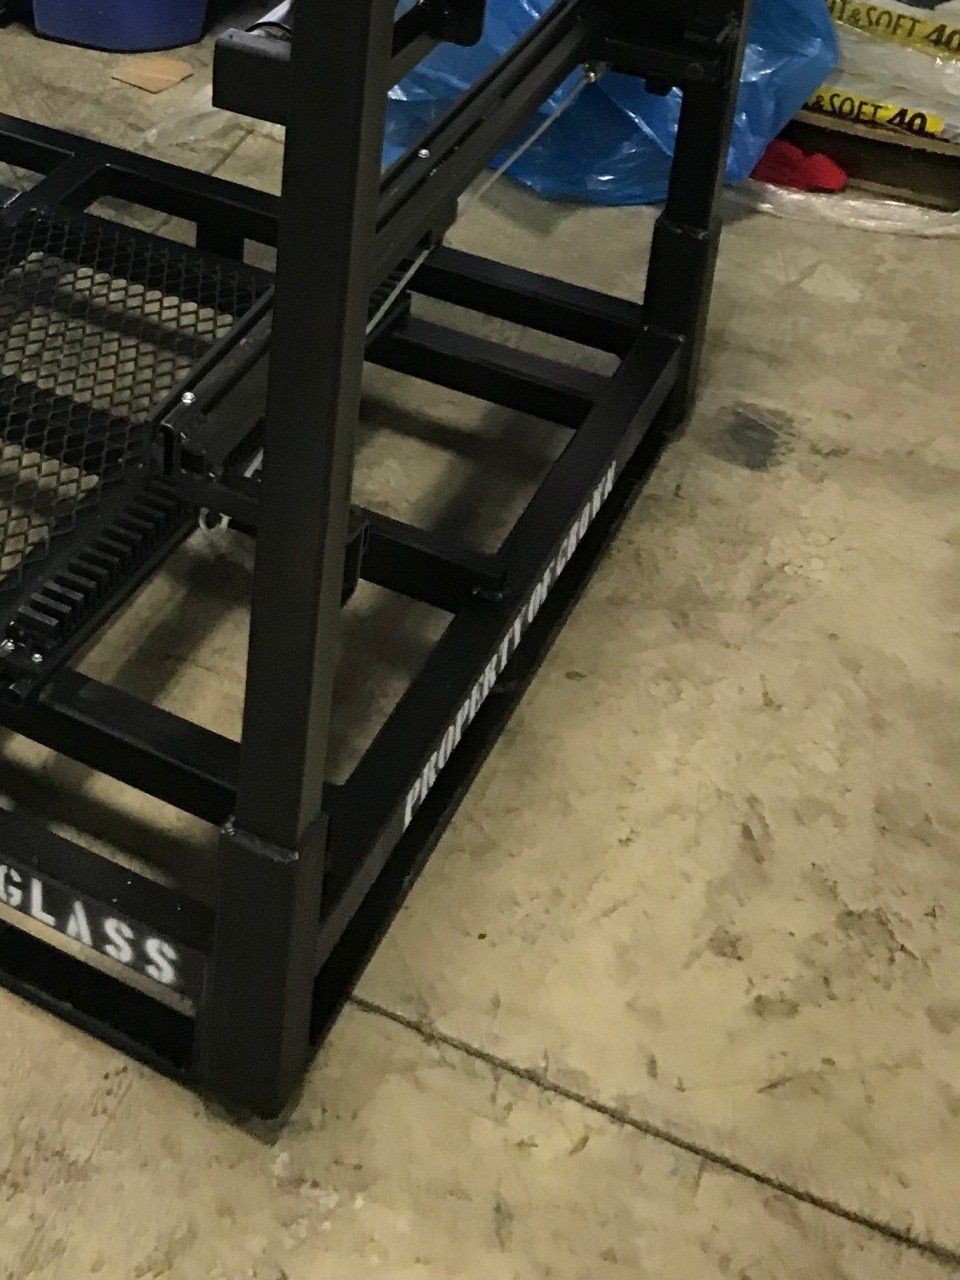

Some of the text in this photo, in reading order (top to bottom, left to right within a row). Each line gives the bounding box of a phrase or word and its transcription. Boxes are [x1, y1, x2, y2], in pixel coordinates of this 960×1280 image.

[889, 108, 928, 136] 40
[403, 604, 527, 833] PROPERTY
[527, 559, 555, 623] OF
